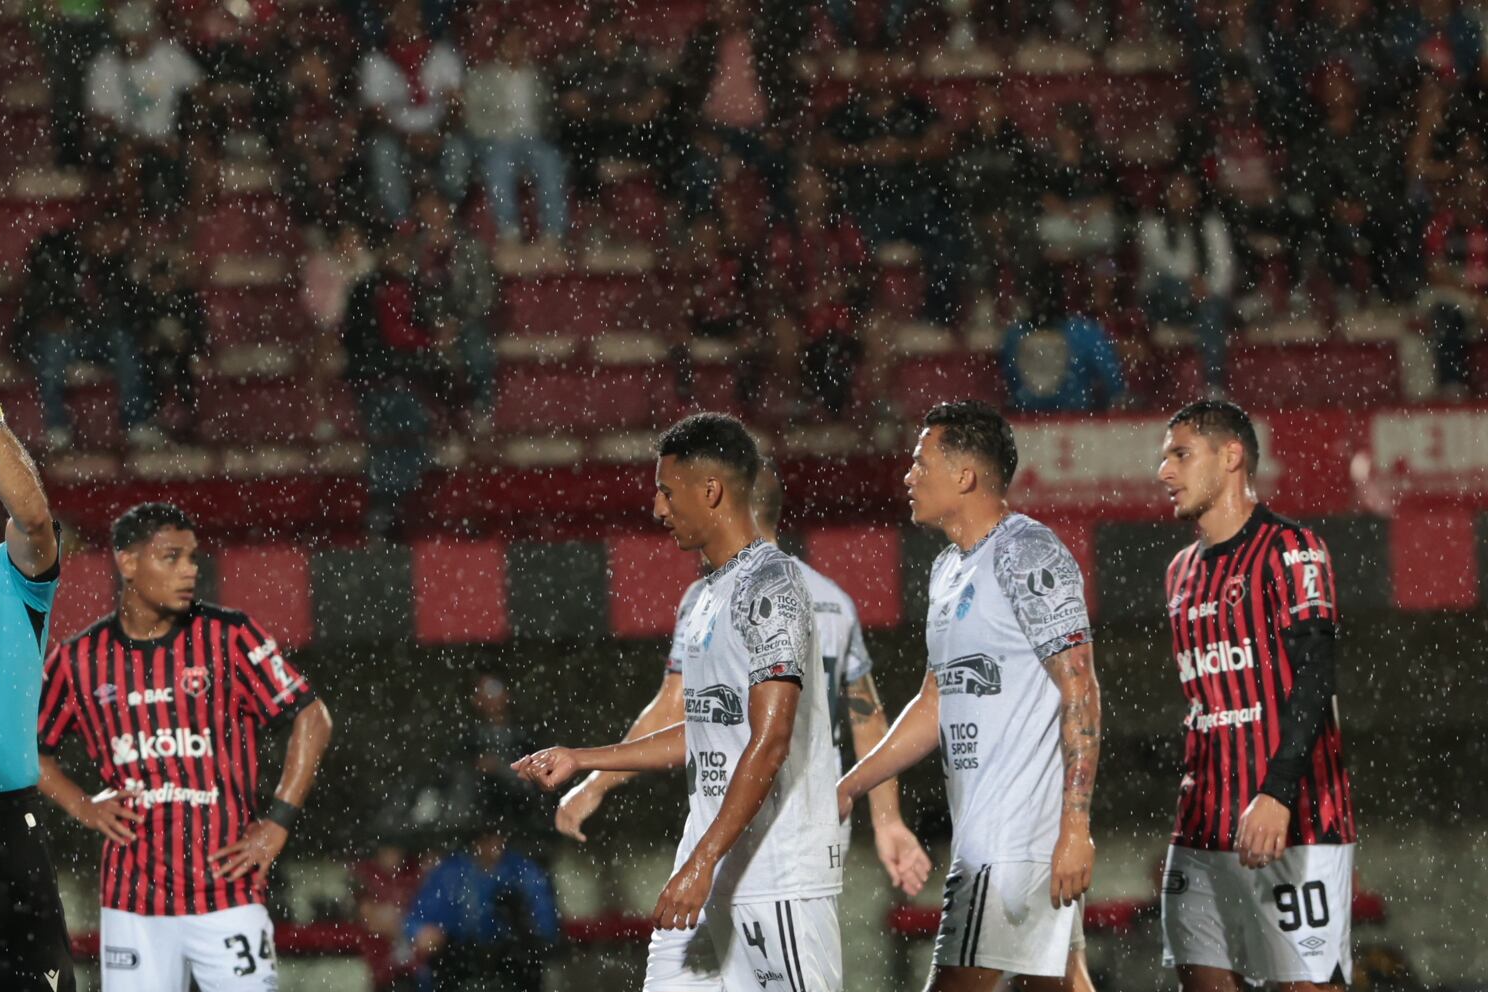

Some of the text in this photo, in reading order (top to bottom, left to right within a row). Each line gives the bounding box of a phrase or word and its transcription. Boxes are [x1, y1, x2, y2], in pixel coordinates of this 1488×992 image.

[1194, 637, 1254, 678] kölbi
[144, 687, 174, 704] BAC
[138, 727, 214, 760] kölbi
[950, 722, 978, 741] TICO
[699, 750, 728, 769] TICO
[951, 741, 979, 756] SPORT
[702, 785, 726, 798] SOCK
[1272, 879, 1330, 932] 90
[224, 929, 277, 977] 34
[742, 920, 768, 960] 4
